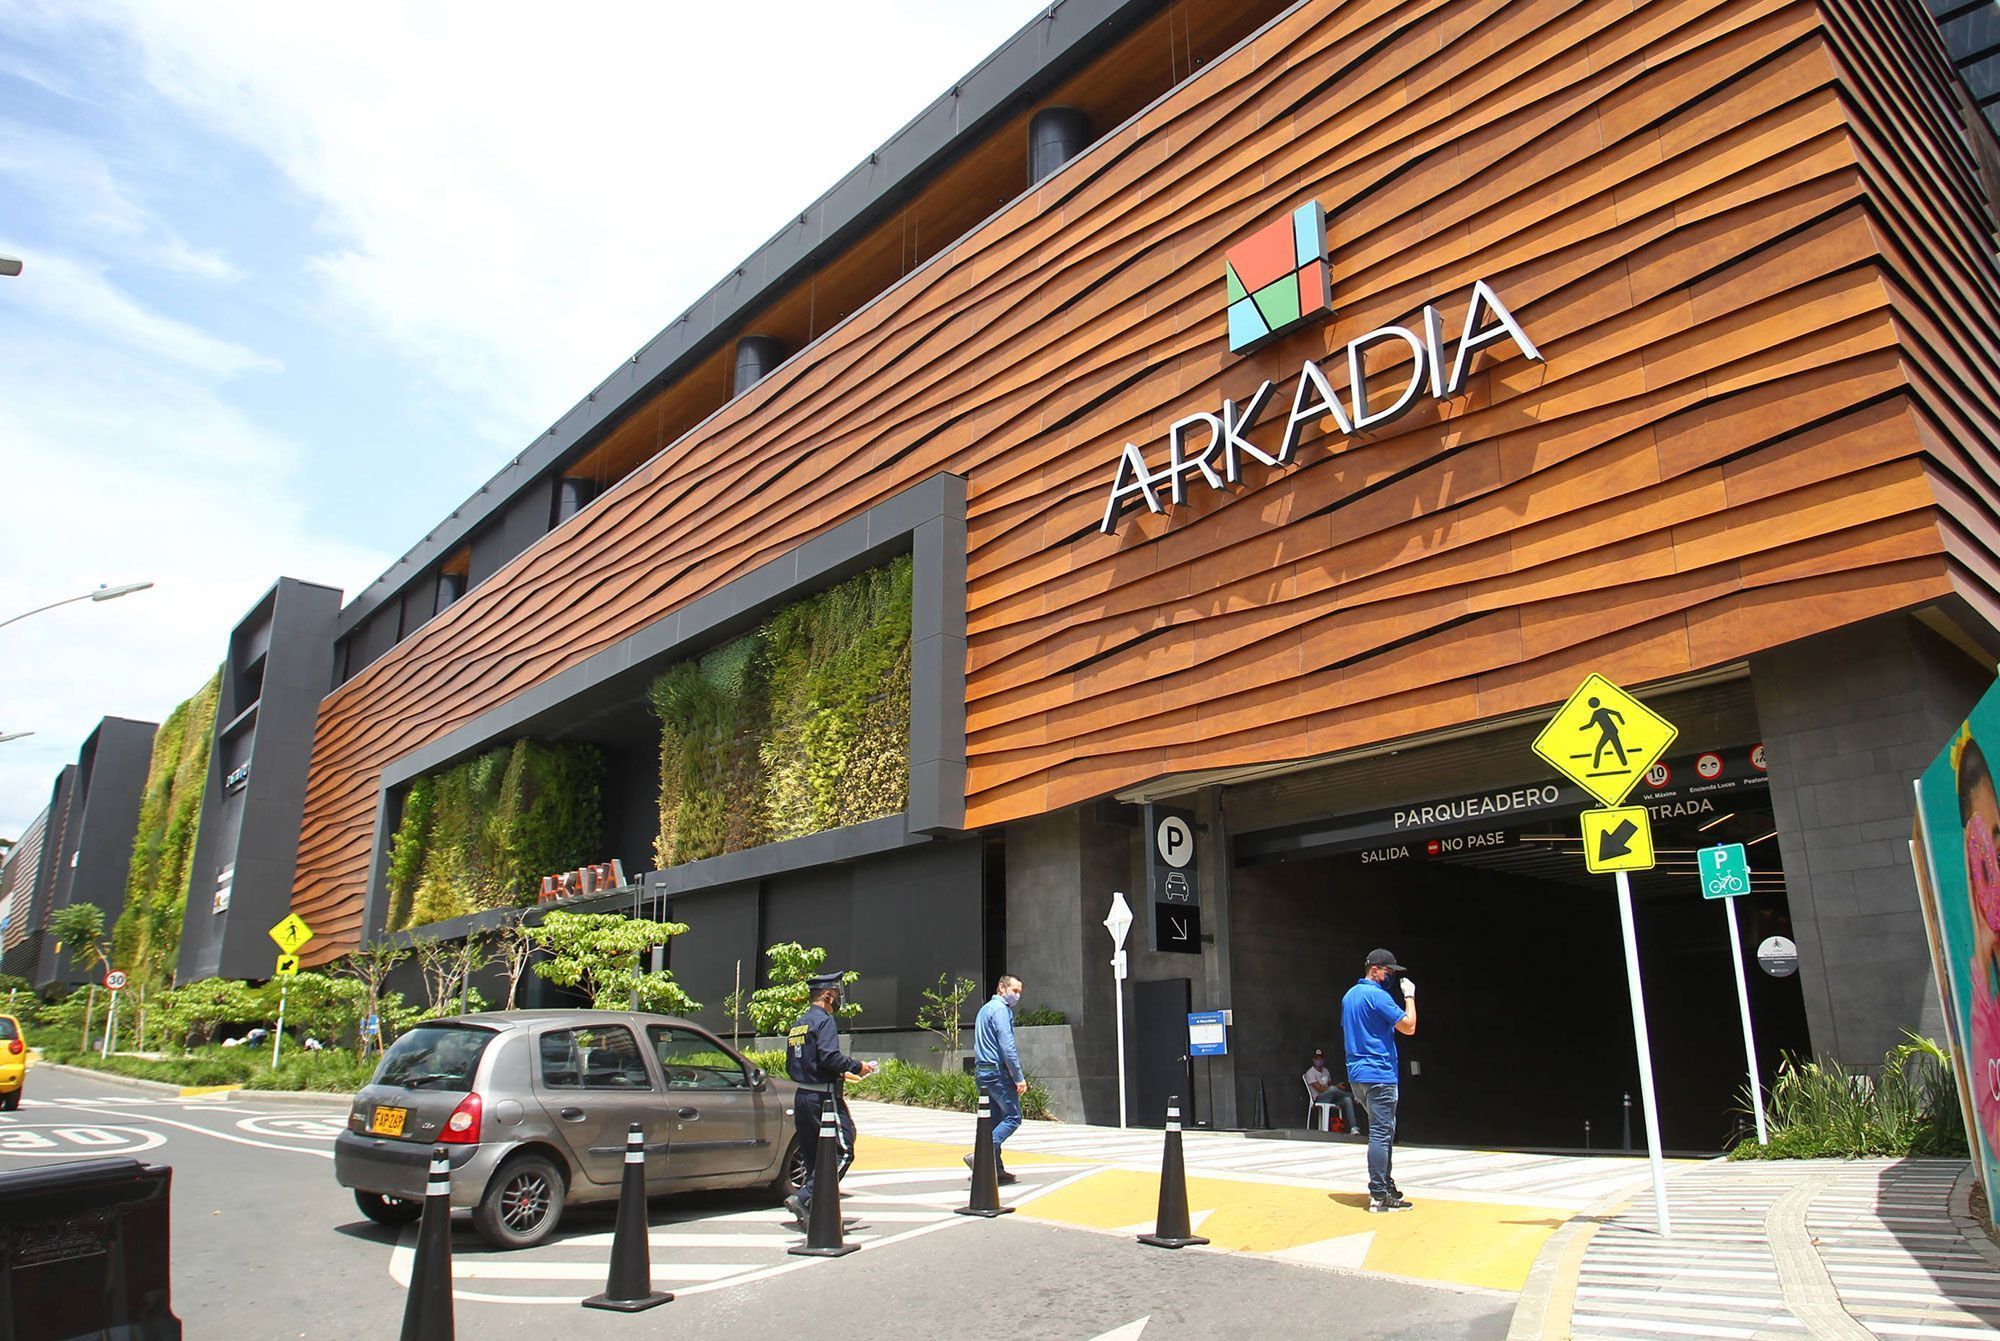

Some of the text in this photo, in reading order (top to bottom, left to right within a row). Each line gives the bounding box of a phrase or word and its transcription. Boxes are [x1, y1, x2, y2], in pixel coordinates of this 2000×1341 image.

[1099, 279, 1546, 534] ARKADIA
[1649, 767, 1665, 779] 10
[1654, 791, 1677, 799] Máxima
[1689, 785, 1717, 793] Encienda
[1393, 785, 1559, 829] PARQUEADERO
[1648, 798, 1714, 820] TRADA
[1167, 826, 1184, 856] P
[1441, 831, 1505, 852] NO PASE
[1361, 846, 1410, 864] SALIDA
[1714, 850, 1728, 870] P
[108, 975, 124, 985] 30
[0, 1128, 131, 1149] 30
